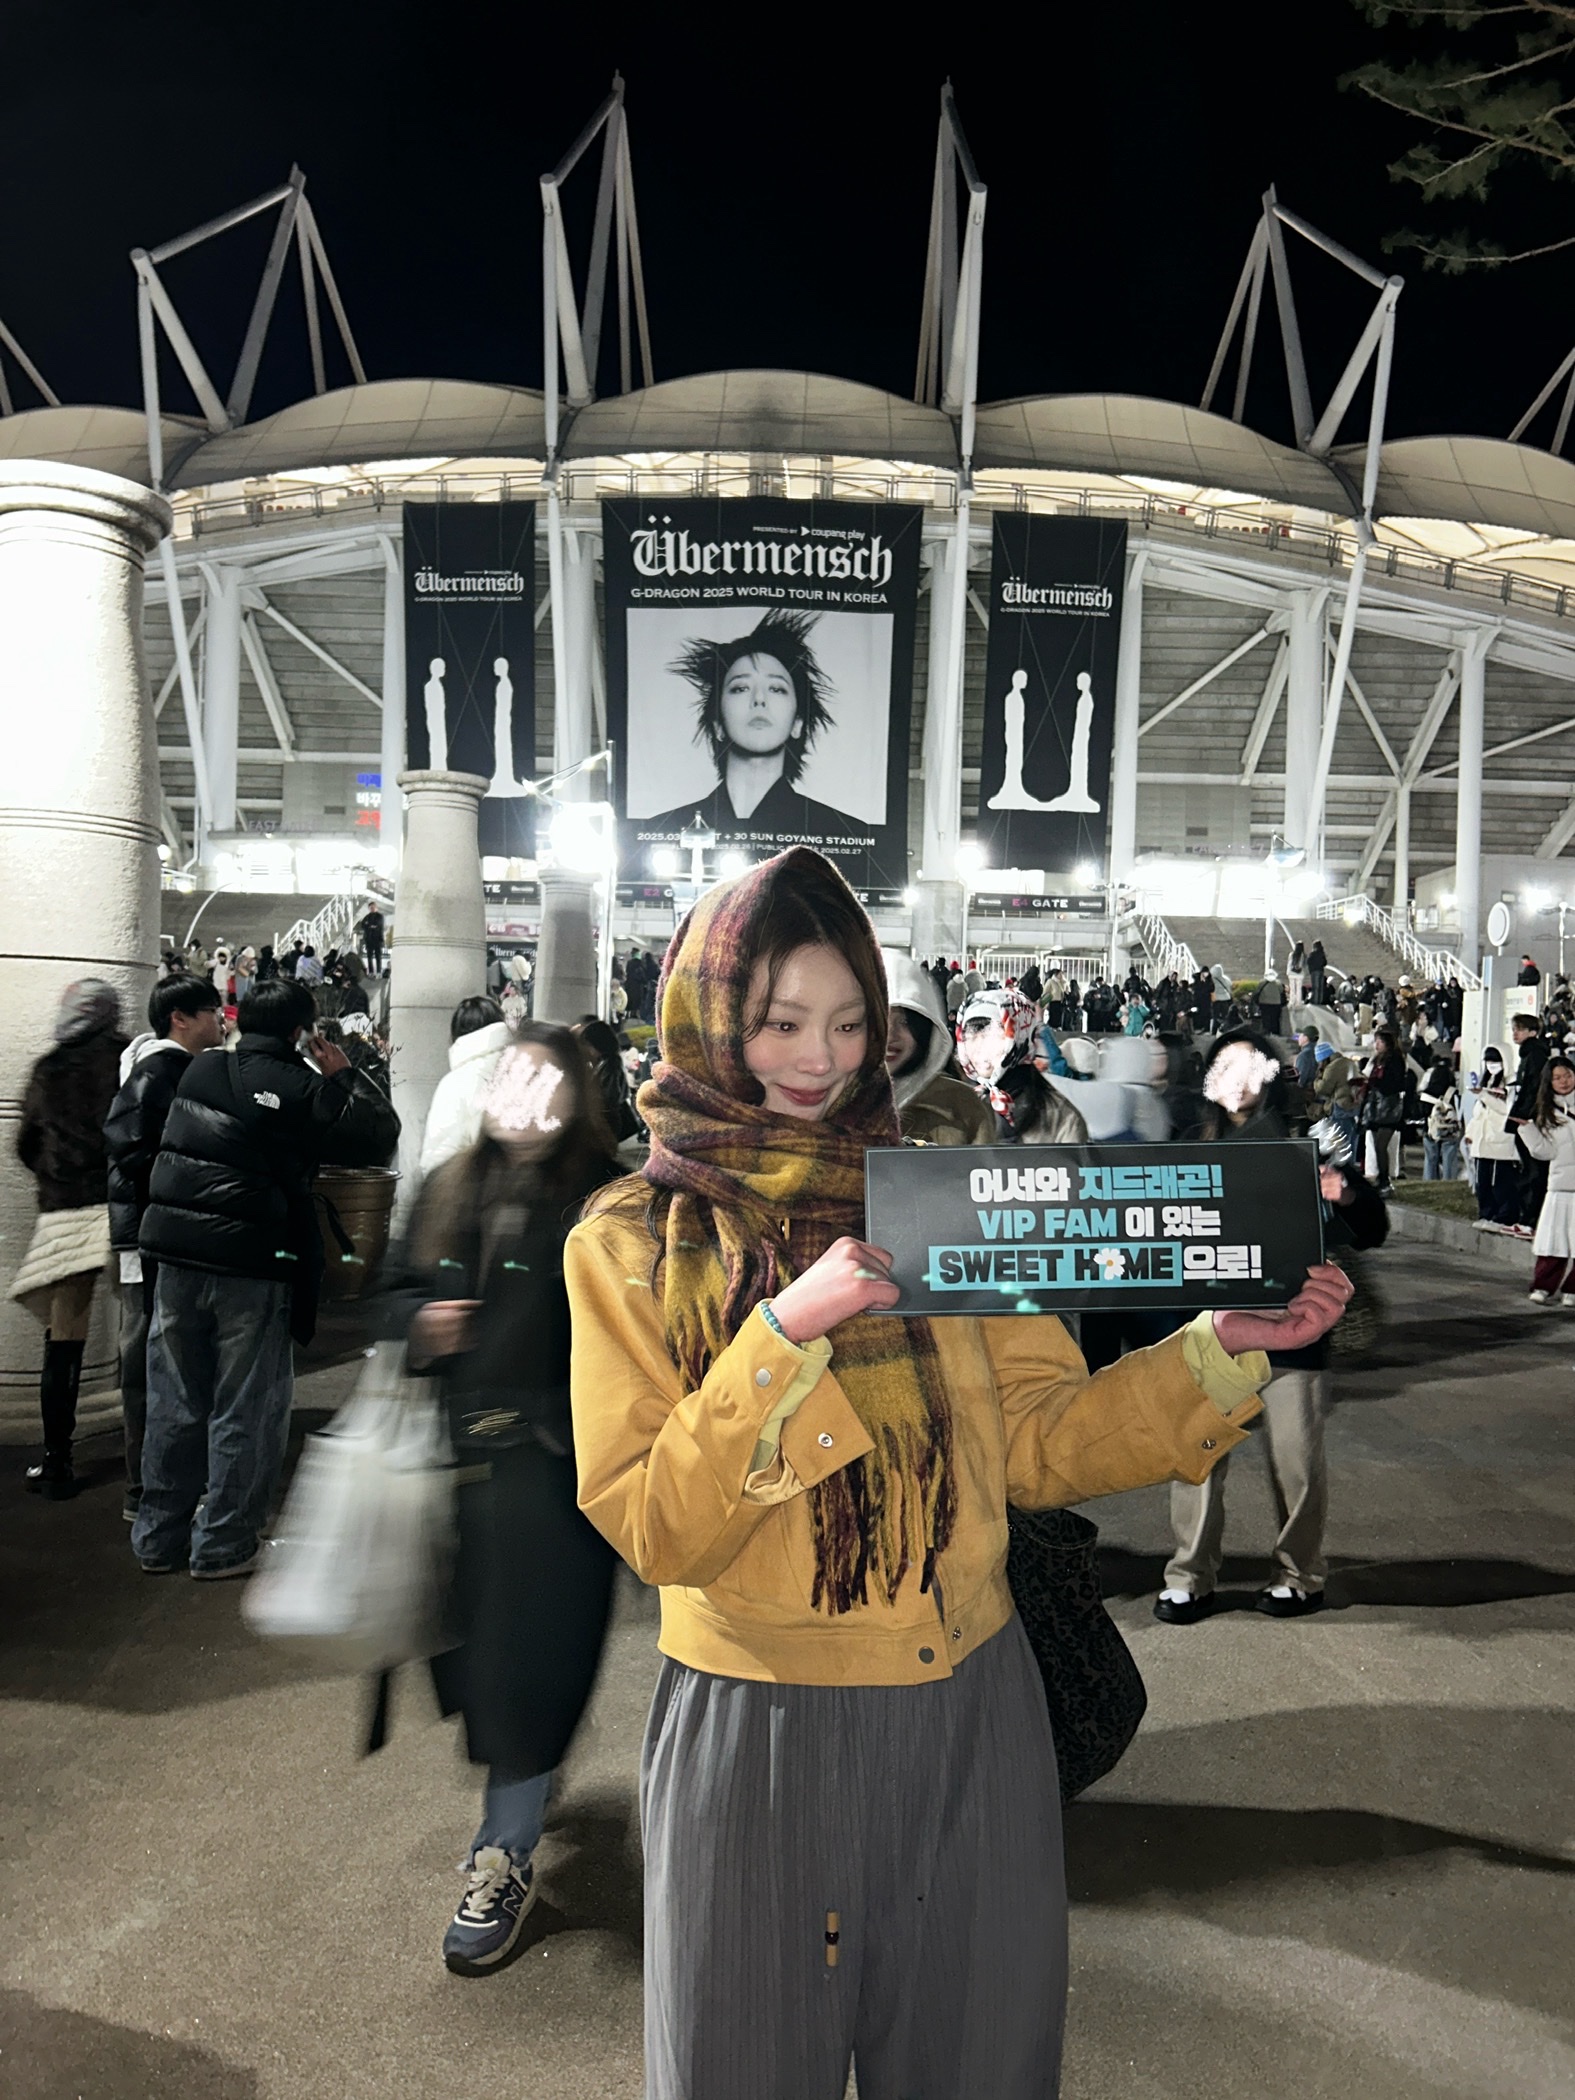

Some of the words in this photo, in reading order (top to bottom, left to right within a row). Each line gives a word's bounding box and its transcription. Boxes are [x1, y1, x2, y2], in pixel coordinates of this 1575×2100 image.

[811, 528, 847, 540] coupang
[848, 530, 865, 541] play
[630, 515, 893, 588] Übermensch
[413, 566, 525, 594] Übermensch
[630, 588, 700, 598] G-DRAGON
[703, 587, 734, 598] 2025
[736, 586, 786, 598] WORLD
[788, 589, 823, 601] TOUR
[826, 591, 840, 601] IN
[844, 593, 888, 604] KOREA
[1001, 576, 1112, 610] Übermensch
[734, 832, 748, 841] 30
[750, 832, 774, 841] SUN
[776, 834, 823, 844] GOYANG
[826, 836, 876, 847] STADIUM
[1032, 899, 1069, 908] GATE
[969, 1167, 1072, 1203] 어서와
[1078, 1164, 1224, 1201] 지드래곤!
[977, 1209, 1037, 1240] VIP
[1044, 1207, 1118, 1239] FAM
[1125, 1206, 1155, 1238] 이
[1161, 1205, 1222, 1237] 있는
[939, 1249, 1064, 1285] SWEET
[1183, 1244, 1263, 1280] 으로!
